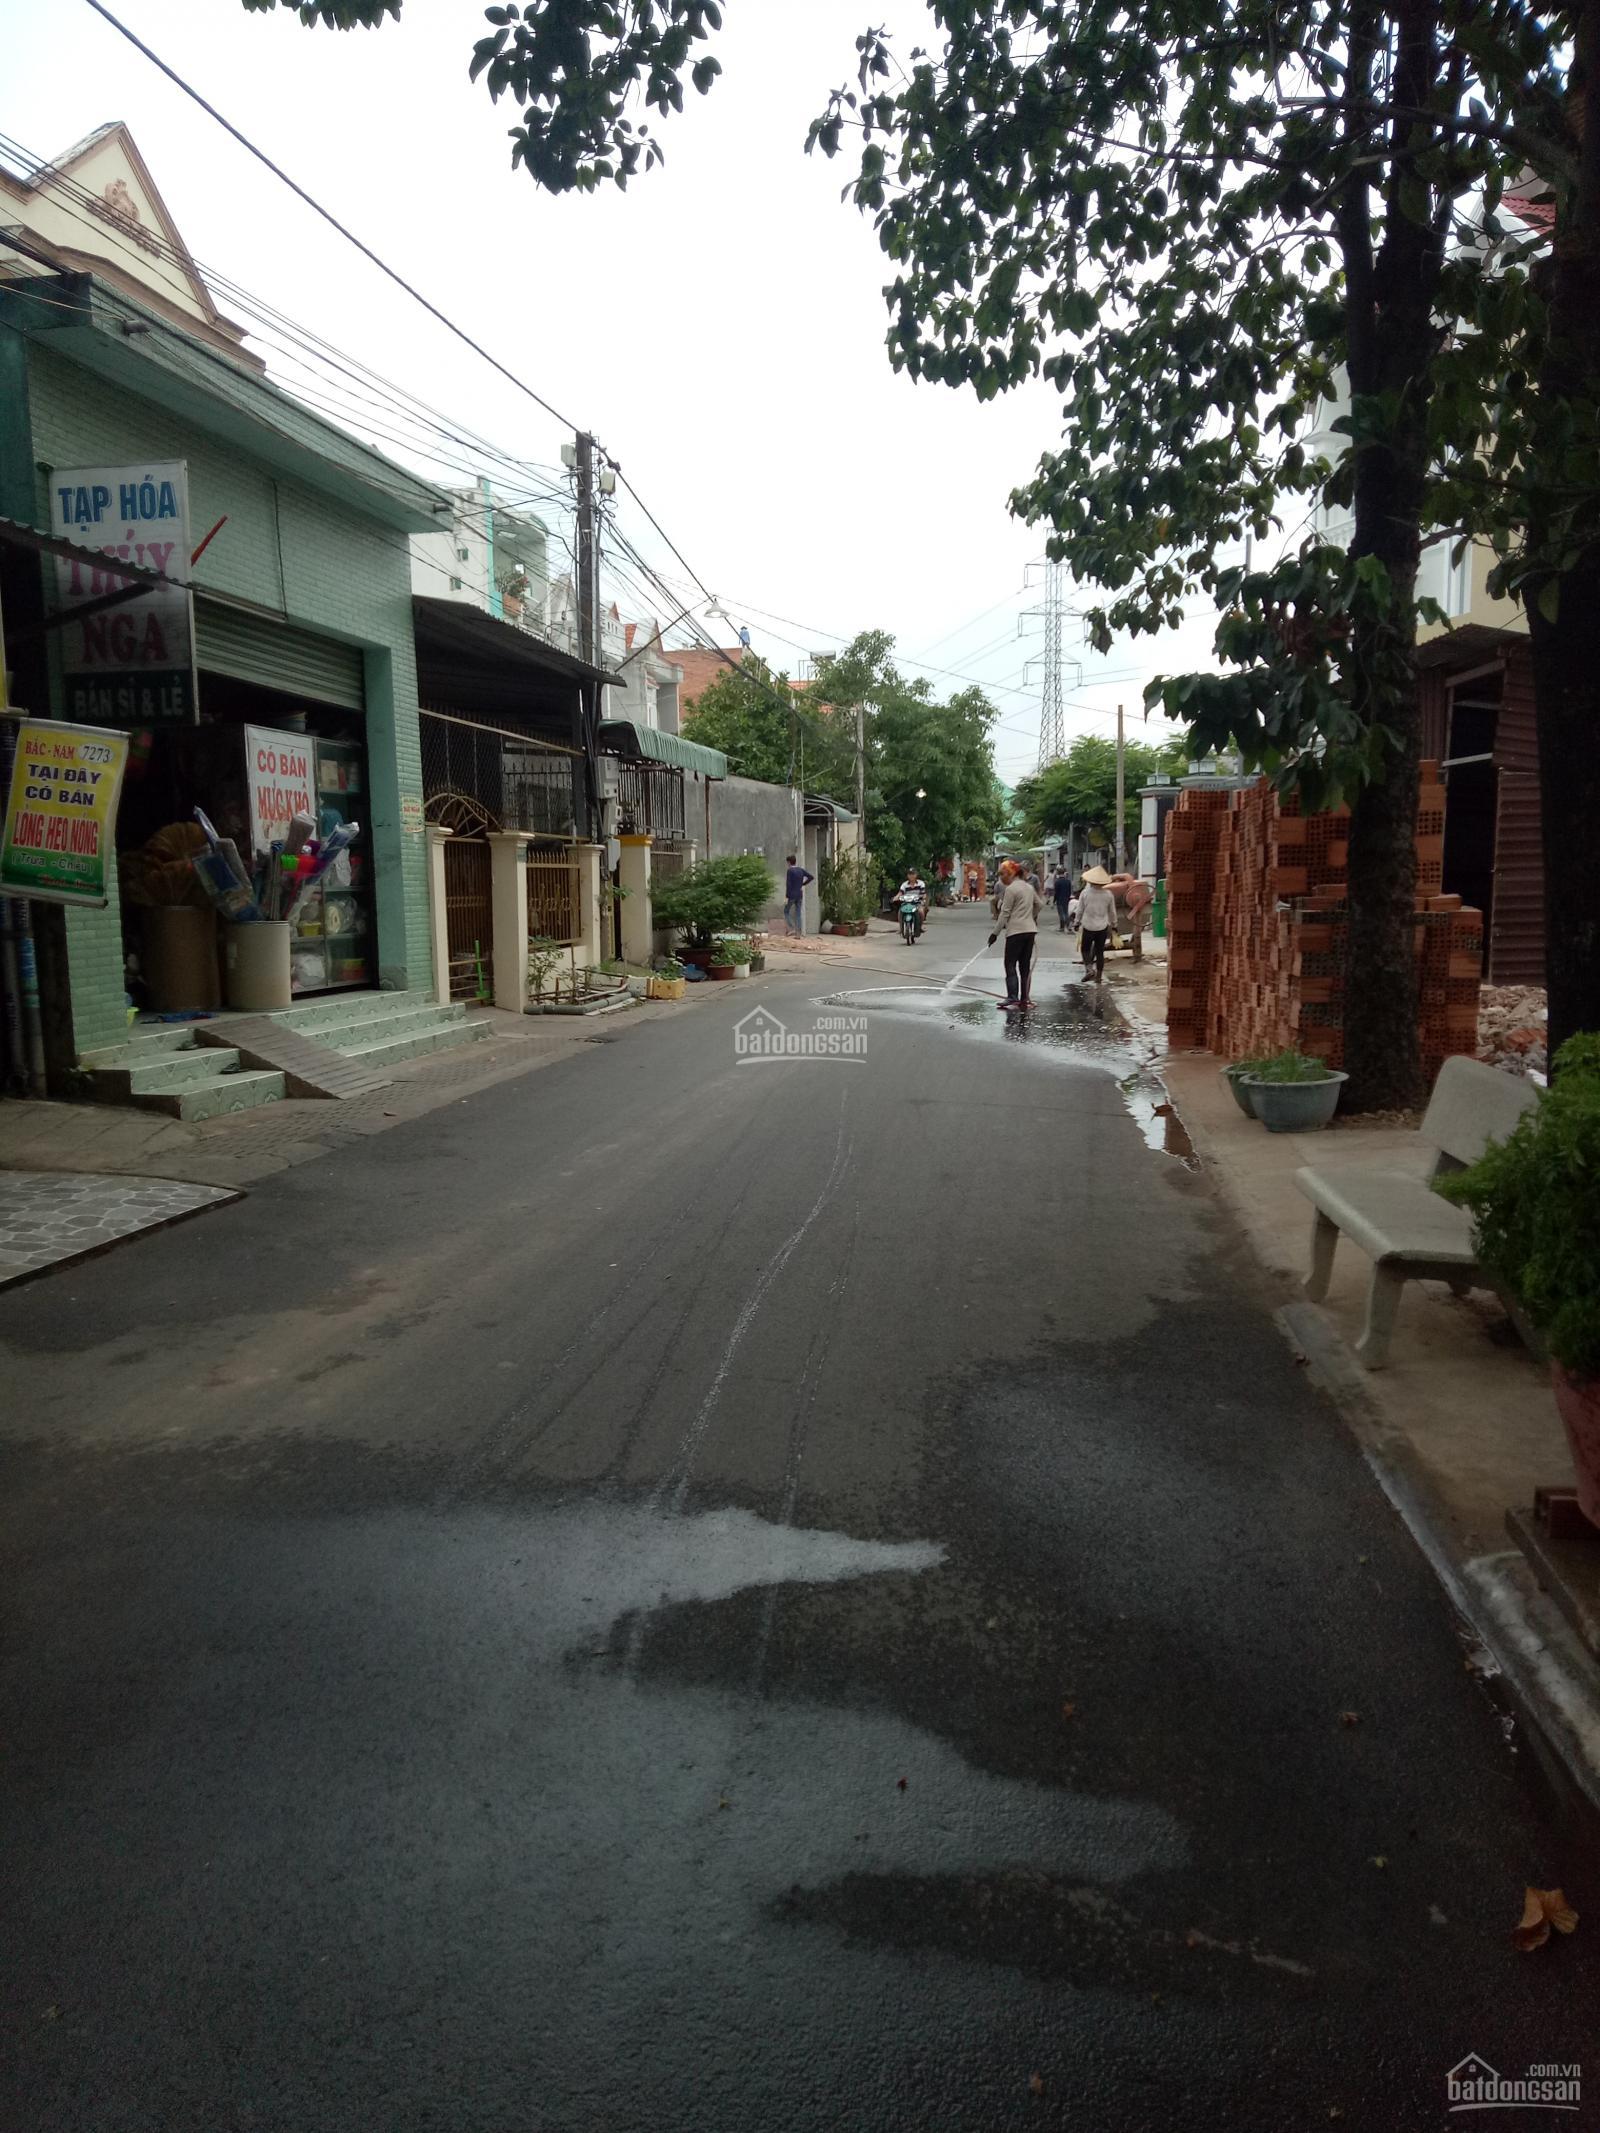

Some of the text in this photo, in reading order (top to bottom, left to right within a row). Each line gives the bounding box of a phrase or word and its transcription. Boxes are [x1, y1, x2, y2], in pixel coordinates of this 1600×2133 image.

[57, 475, 177, 532] TẠP HÓA
[80, 612, 168, 665] NGA
[75, 680, 112, 719] BÁN
[142, 688, 155, 717] &
[160, 675, 184, 717] LẺ
[53, 743, 75, 760] NAM
[82, 745, 110, 763] 7273
[257, 745, 306, 778] CÓ BÁN
[28, 764, 101, 785] TẠI ĐÂY
[25, 785, 94, 806] CÓ BÁN
[45, 815, 69, 851] HEO
